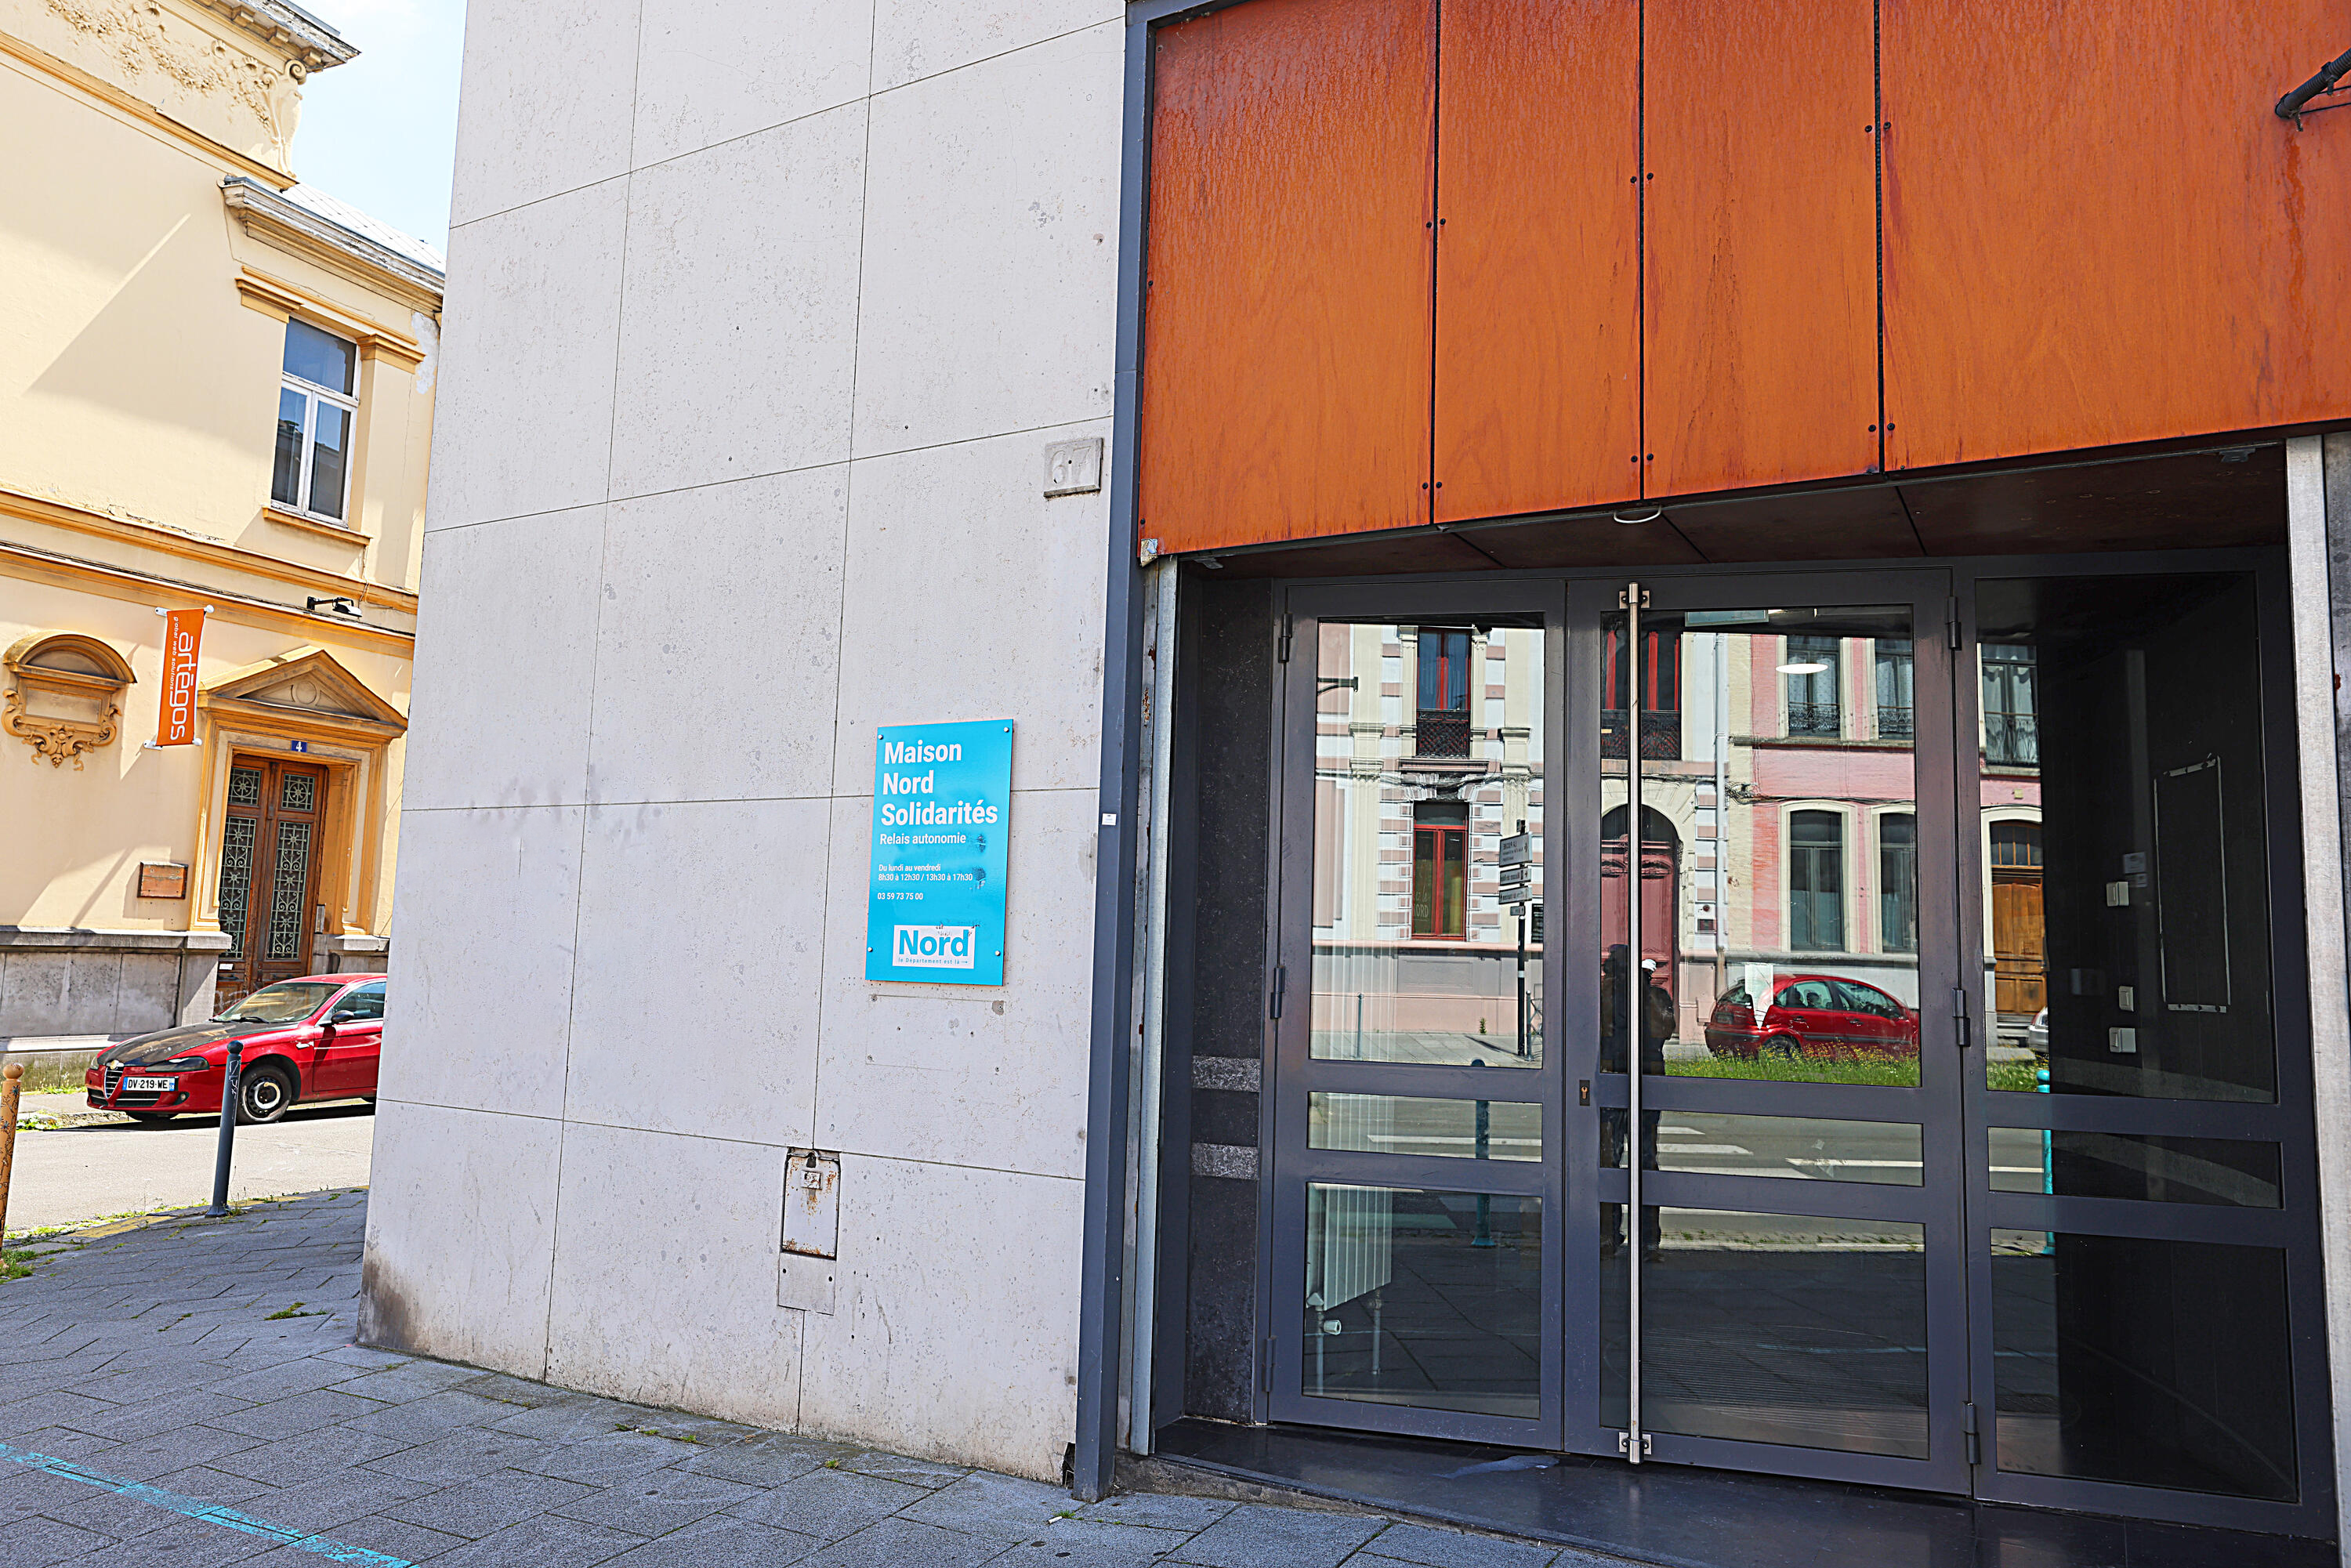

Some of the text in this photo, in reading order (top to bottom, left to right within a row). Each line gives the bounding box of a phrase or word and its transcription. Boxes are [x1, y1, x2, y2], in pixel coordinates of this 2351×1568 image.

[1052, 445, 1092, 484] 67
[295, 741, 302, 752] 4
[884, 740, 962, 764] Maison
[882, 770, 934, 795] Nord
[881, 799, 998, 826] Solidarités
[879, 831, 966, 845] Relais autonomie
[921, 873, 925, 882] /
[899, 929, 969, 957] Nord
